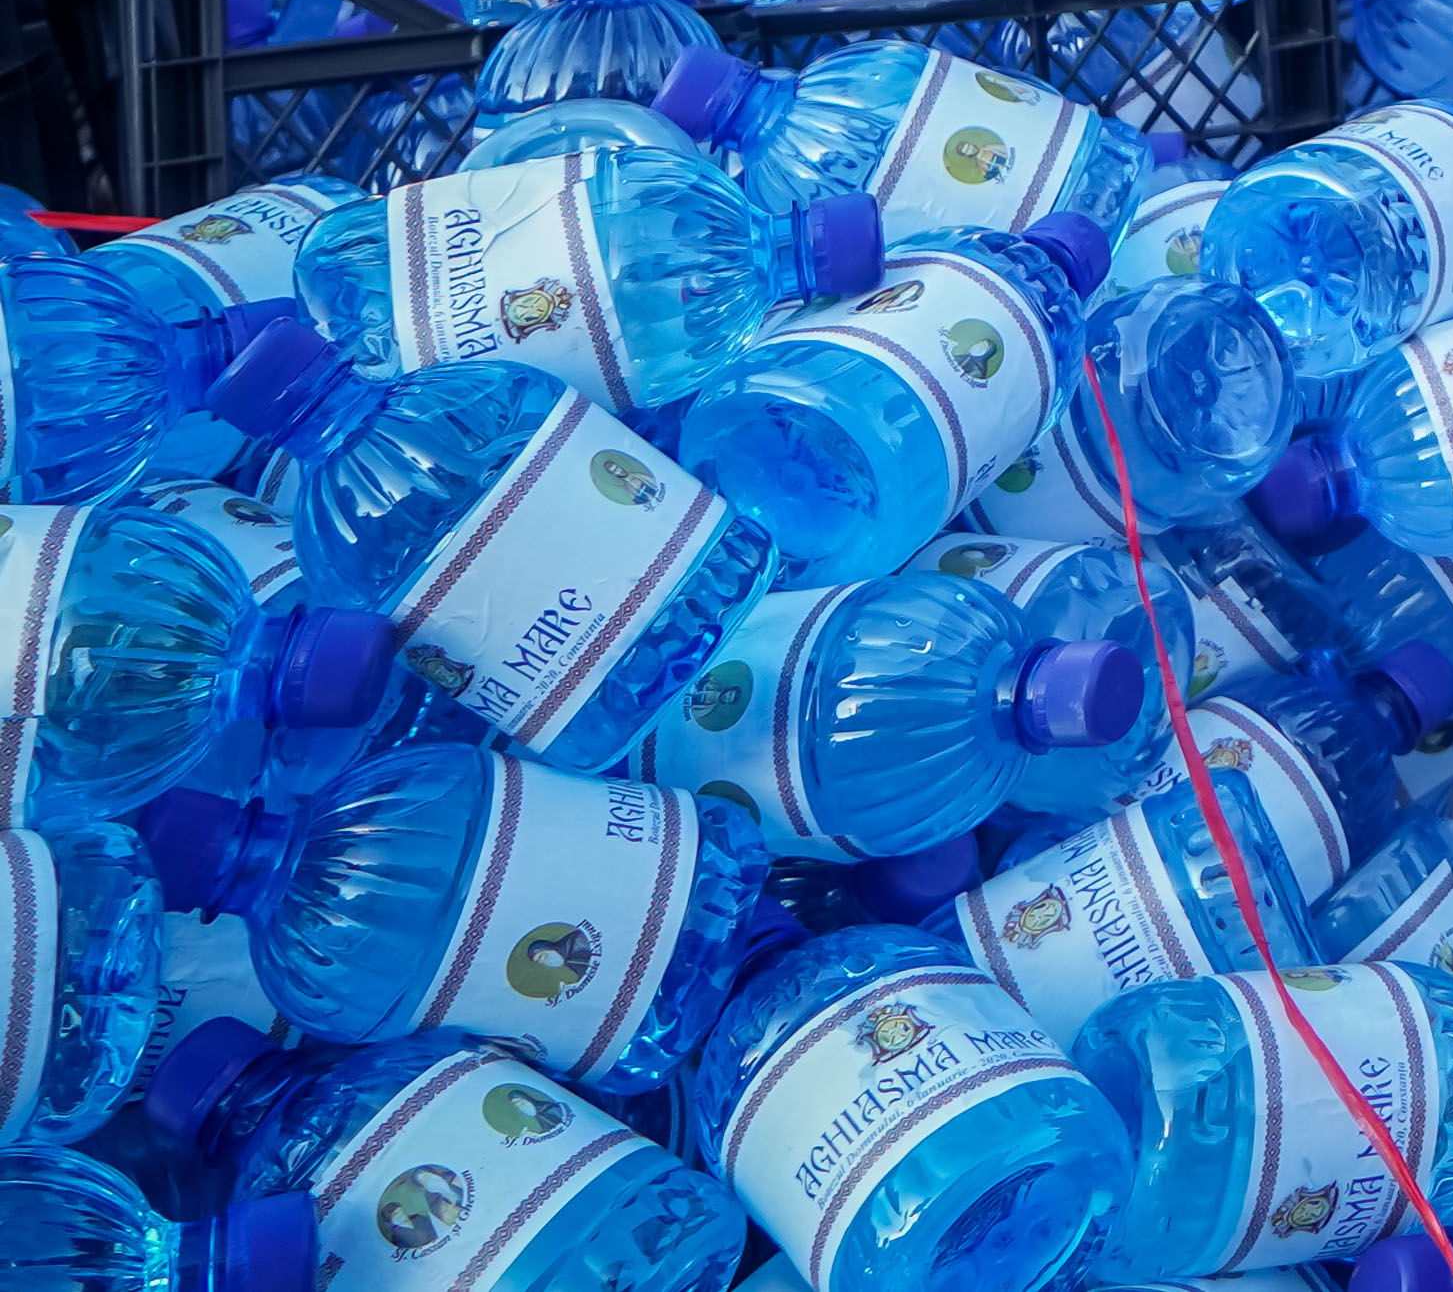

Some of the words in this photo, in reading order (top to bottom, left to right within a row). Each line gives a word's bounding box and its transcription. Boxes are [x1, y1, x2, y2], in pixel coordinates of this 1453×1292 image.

[1377, 131, 1444, 181] MARE
[443, 206, 504, 360] AGHIASMĂ
[501, 588, 593, 682] MARE
[1066, 854, 1154, 992] GHIASMĂ
[795, 1037, 961, 1201] AGHIASMĂ
[964, 1029, 1053, 1055] MARE
[1319, 1174, 1386, 1259] IASMĂ
